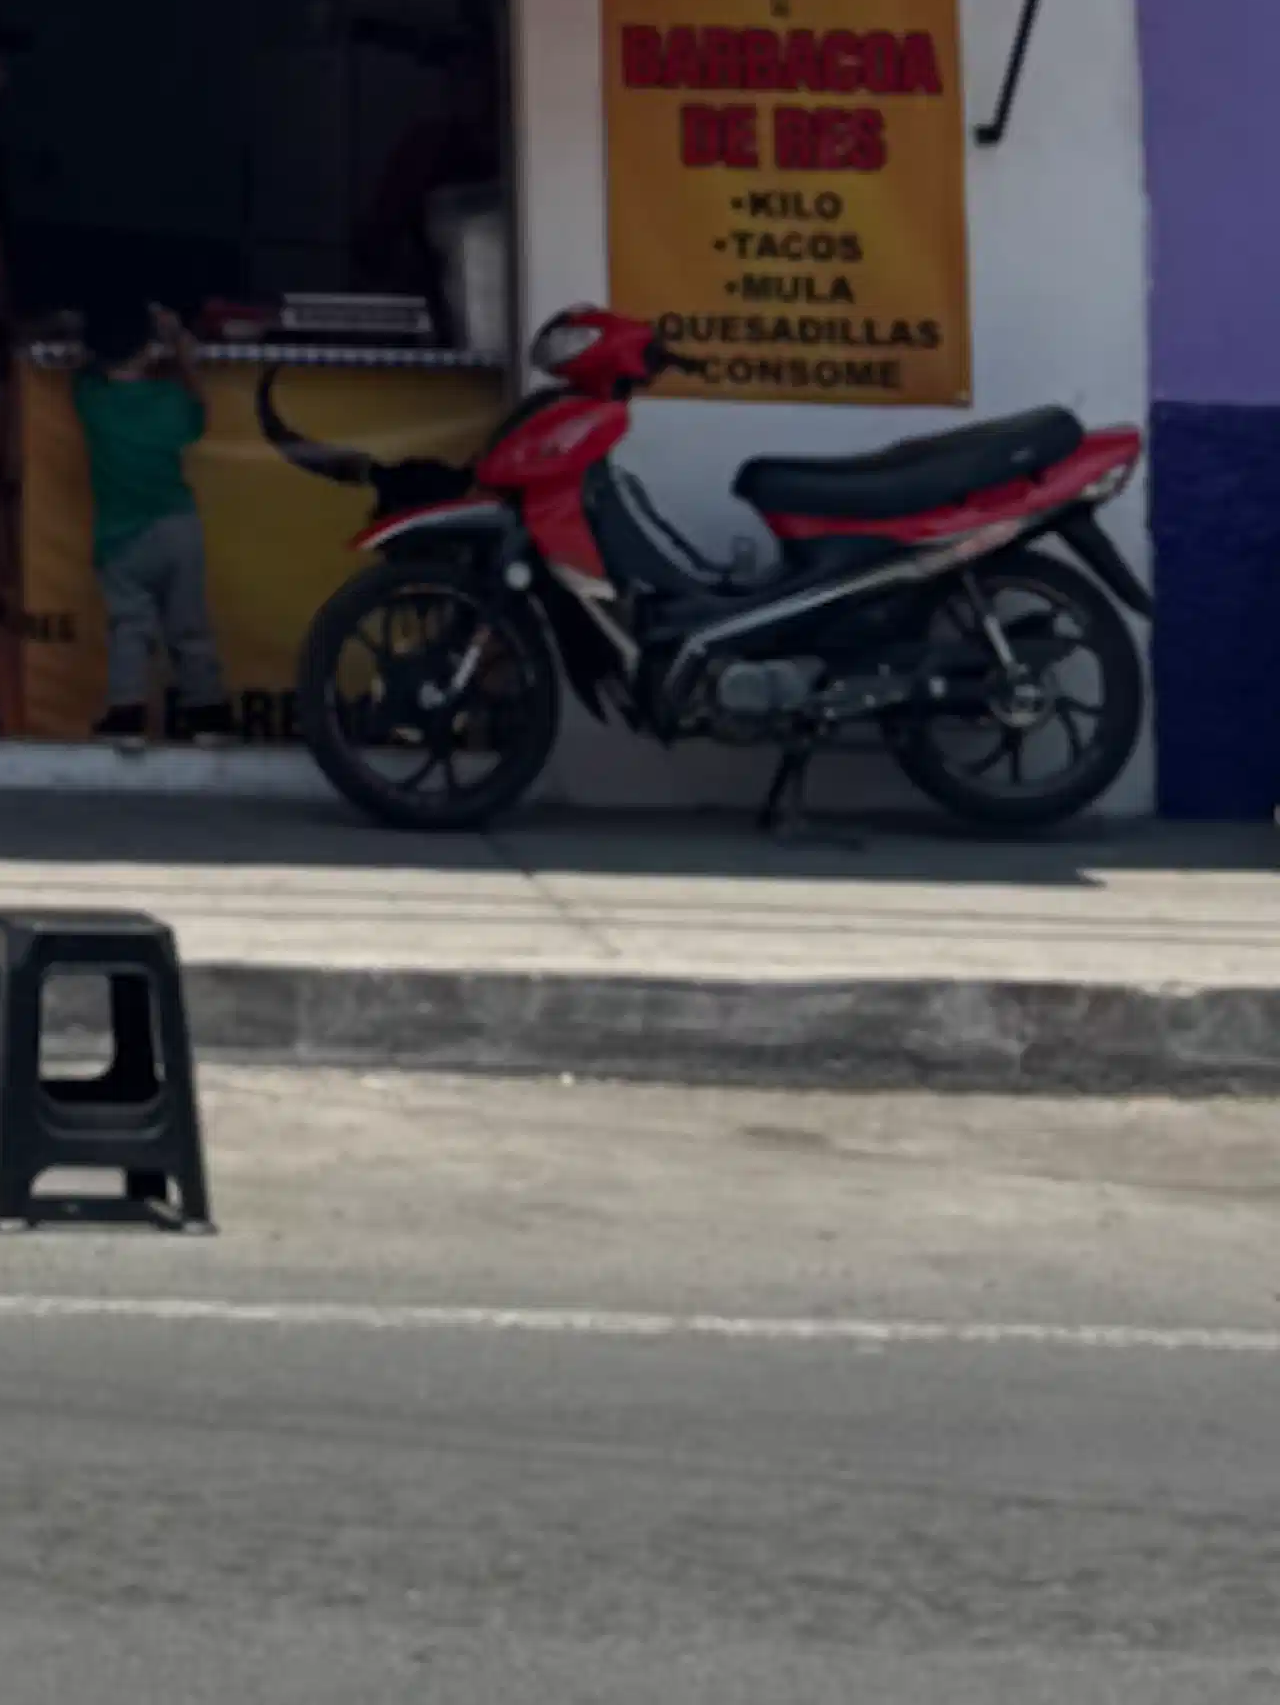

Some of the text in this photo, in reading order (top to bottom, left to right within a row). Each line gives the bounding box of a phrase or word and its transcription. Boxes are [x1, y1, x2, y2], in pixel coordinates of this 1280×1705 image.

[622, 24, 943, 95] BARBACOA
[680, 104, 888, 171] DE RES
[748, 190, 845, 221] KILO
[730, 231, 864, 262] TACOS
[742, 274, 855, 304] MULA
[658, 311, 943, 350] QUESADILLAS
